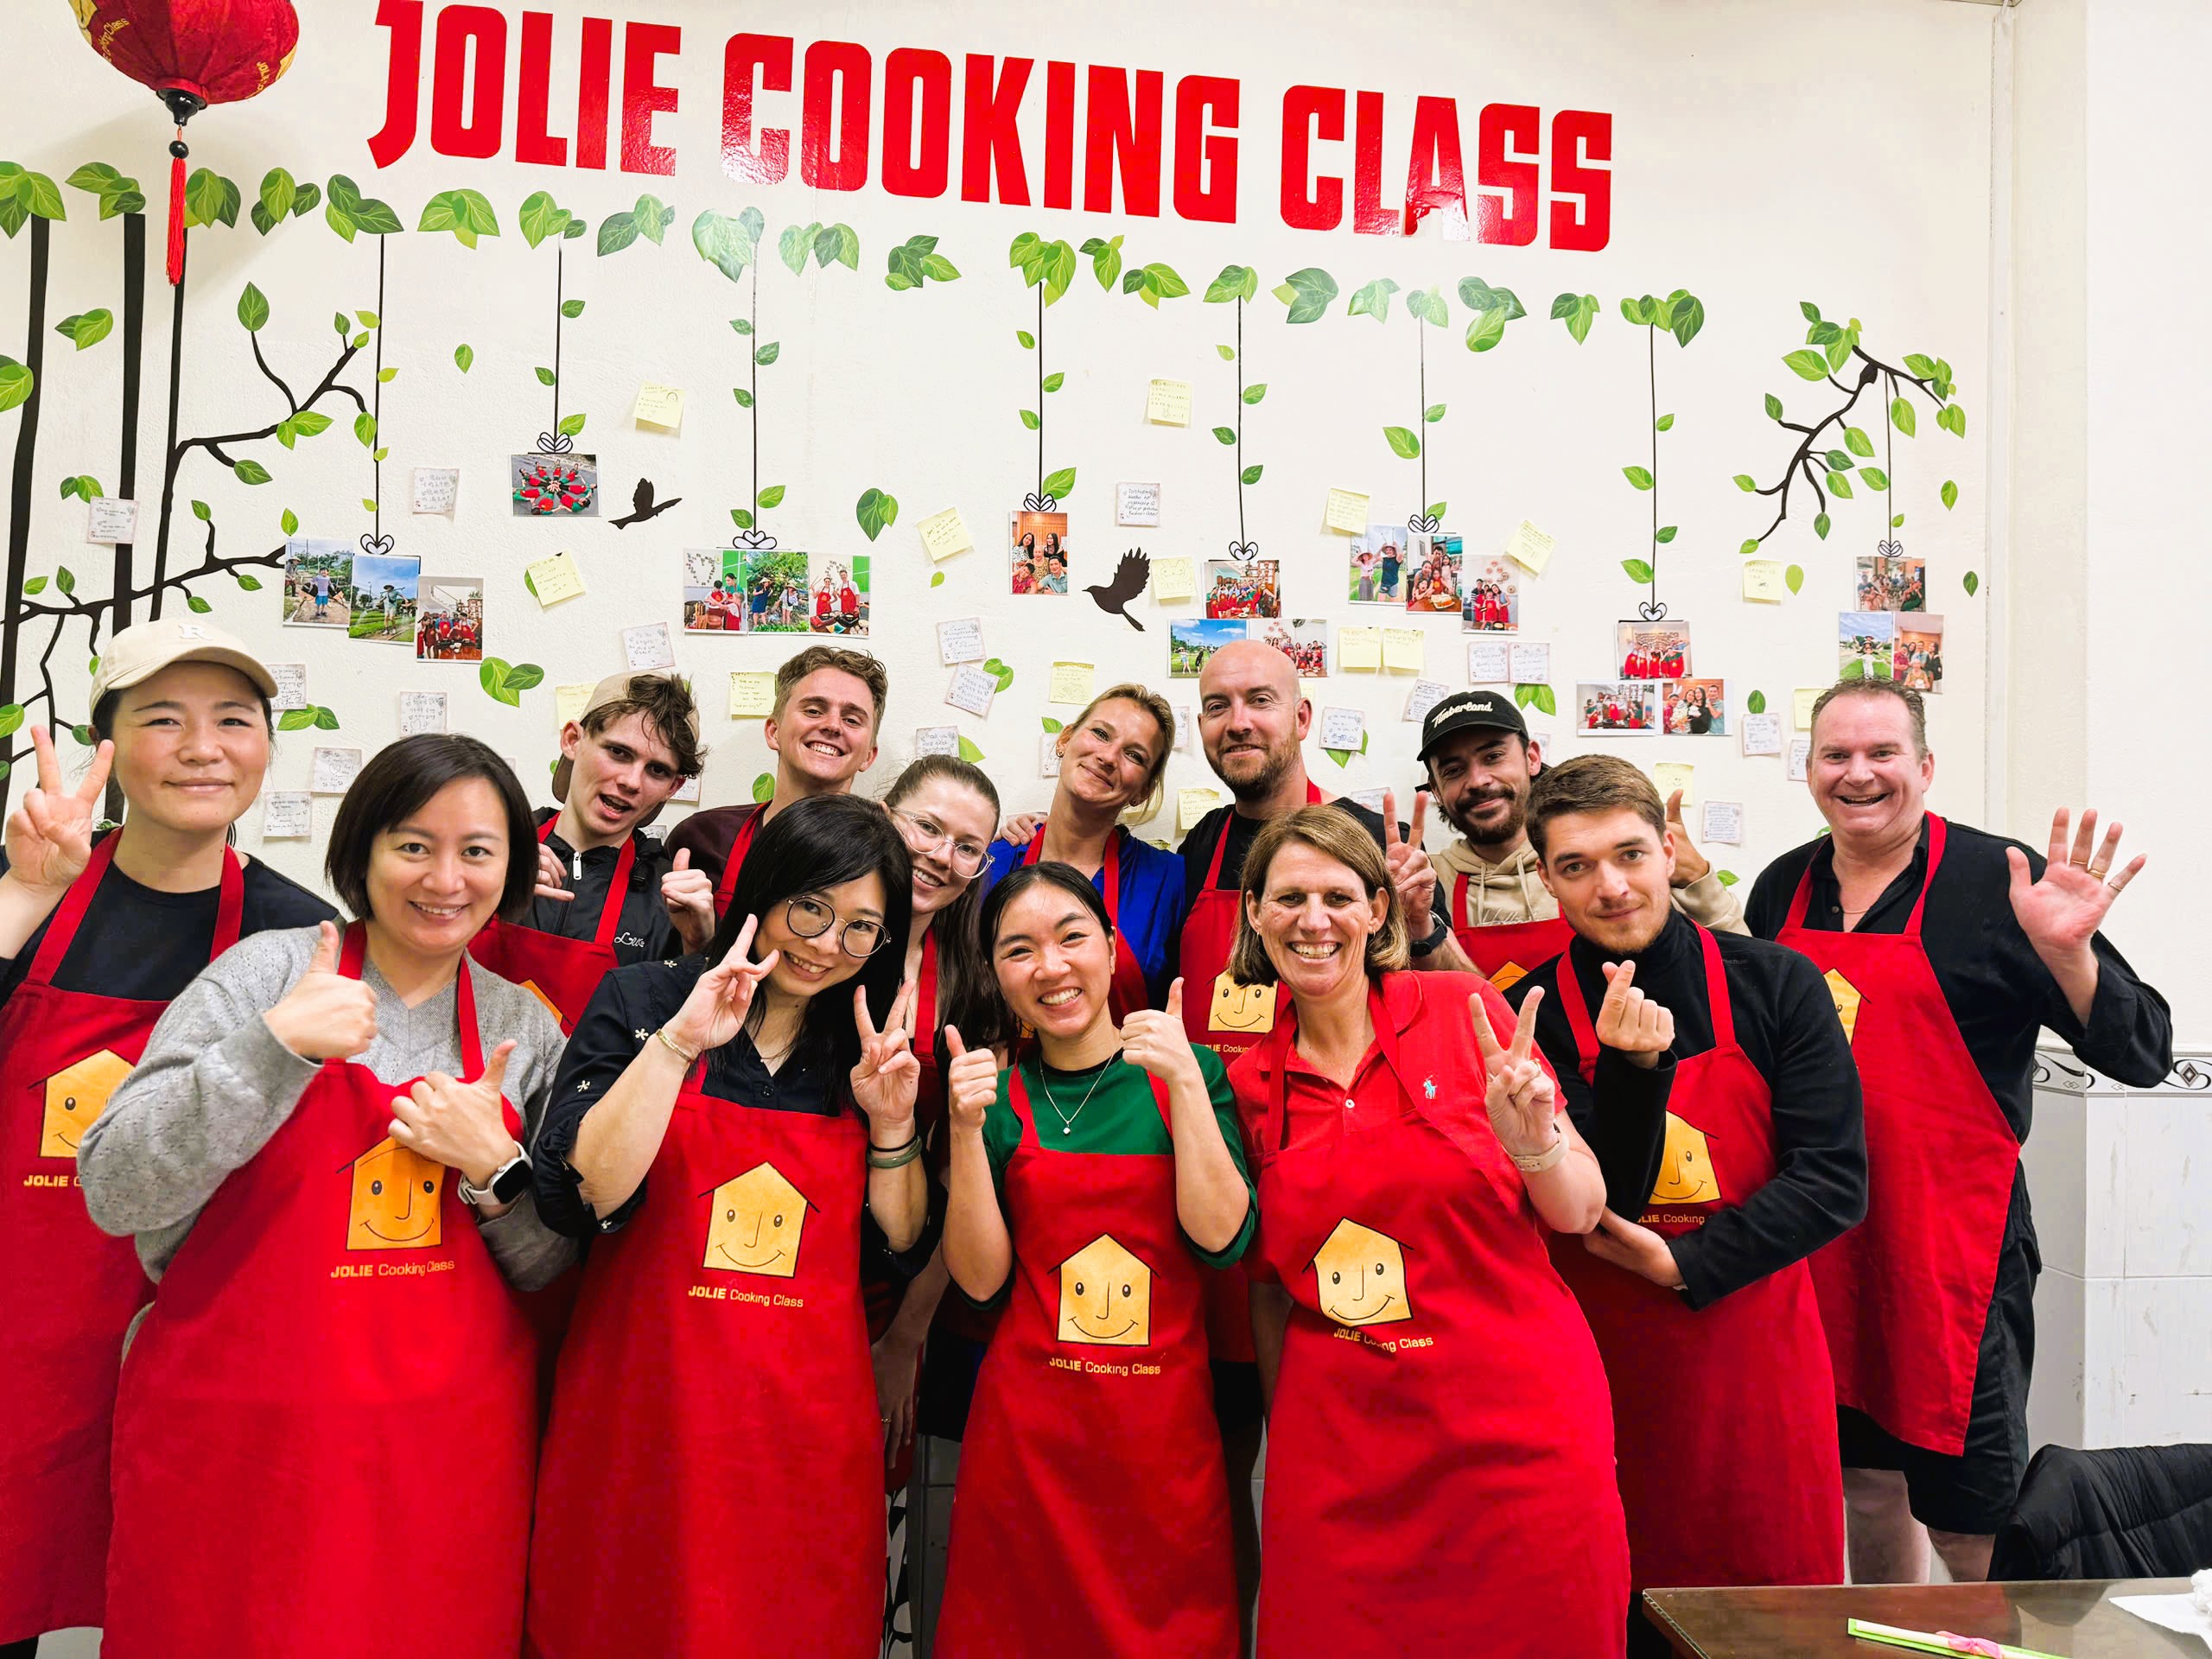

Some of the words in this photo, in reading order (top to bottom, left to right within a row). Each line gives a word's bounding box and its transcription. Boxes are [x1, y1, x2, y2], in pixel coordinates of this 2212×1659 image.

[367, 0, 682, 176] JOLIE
[720, 32, 1240, 224] COOKING
[1280, 84, 1613, 252] CLASS
[1431, 701, 1493, 728] Timberland
[23, 1174, 68, 1187] JOLIE
[1663, 1213, 1705, 1225] Cooking
[331, 1264, 374, 1278] JOLIE
[378, 1262, 426, 1277] Cooking
[427, 1260, 455, 1273] Class
[688, 1285, 727, 1300] JOLIE
[730, 1289, 770, 1306] Cooking
[773, 1294, 804, 1307] Class
[1333, 1327, 1362, 1342] JOLIE
[1399, 1337, 1433, 1349] Class
[1049, 1357, 1081, 1371] JOLIE
[1085, 1361, 1128, 1376] Cooking
[1132, 1363, 1161, 1375] Class
